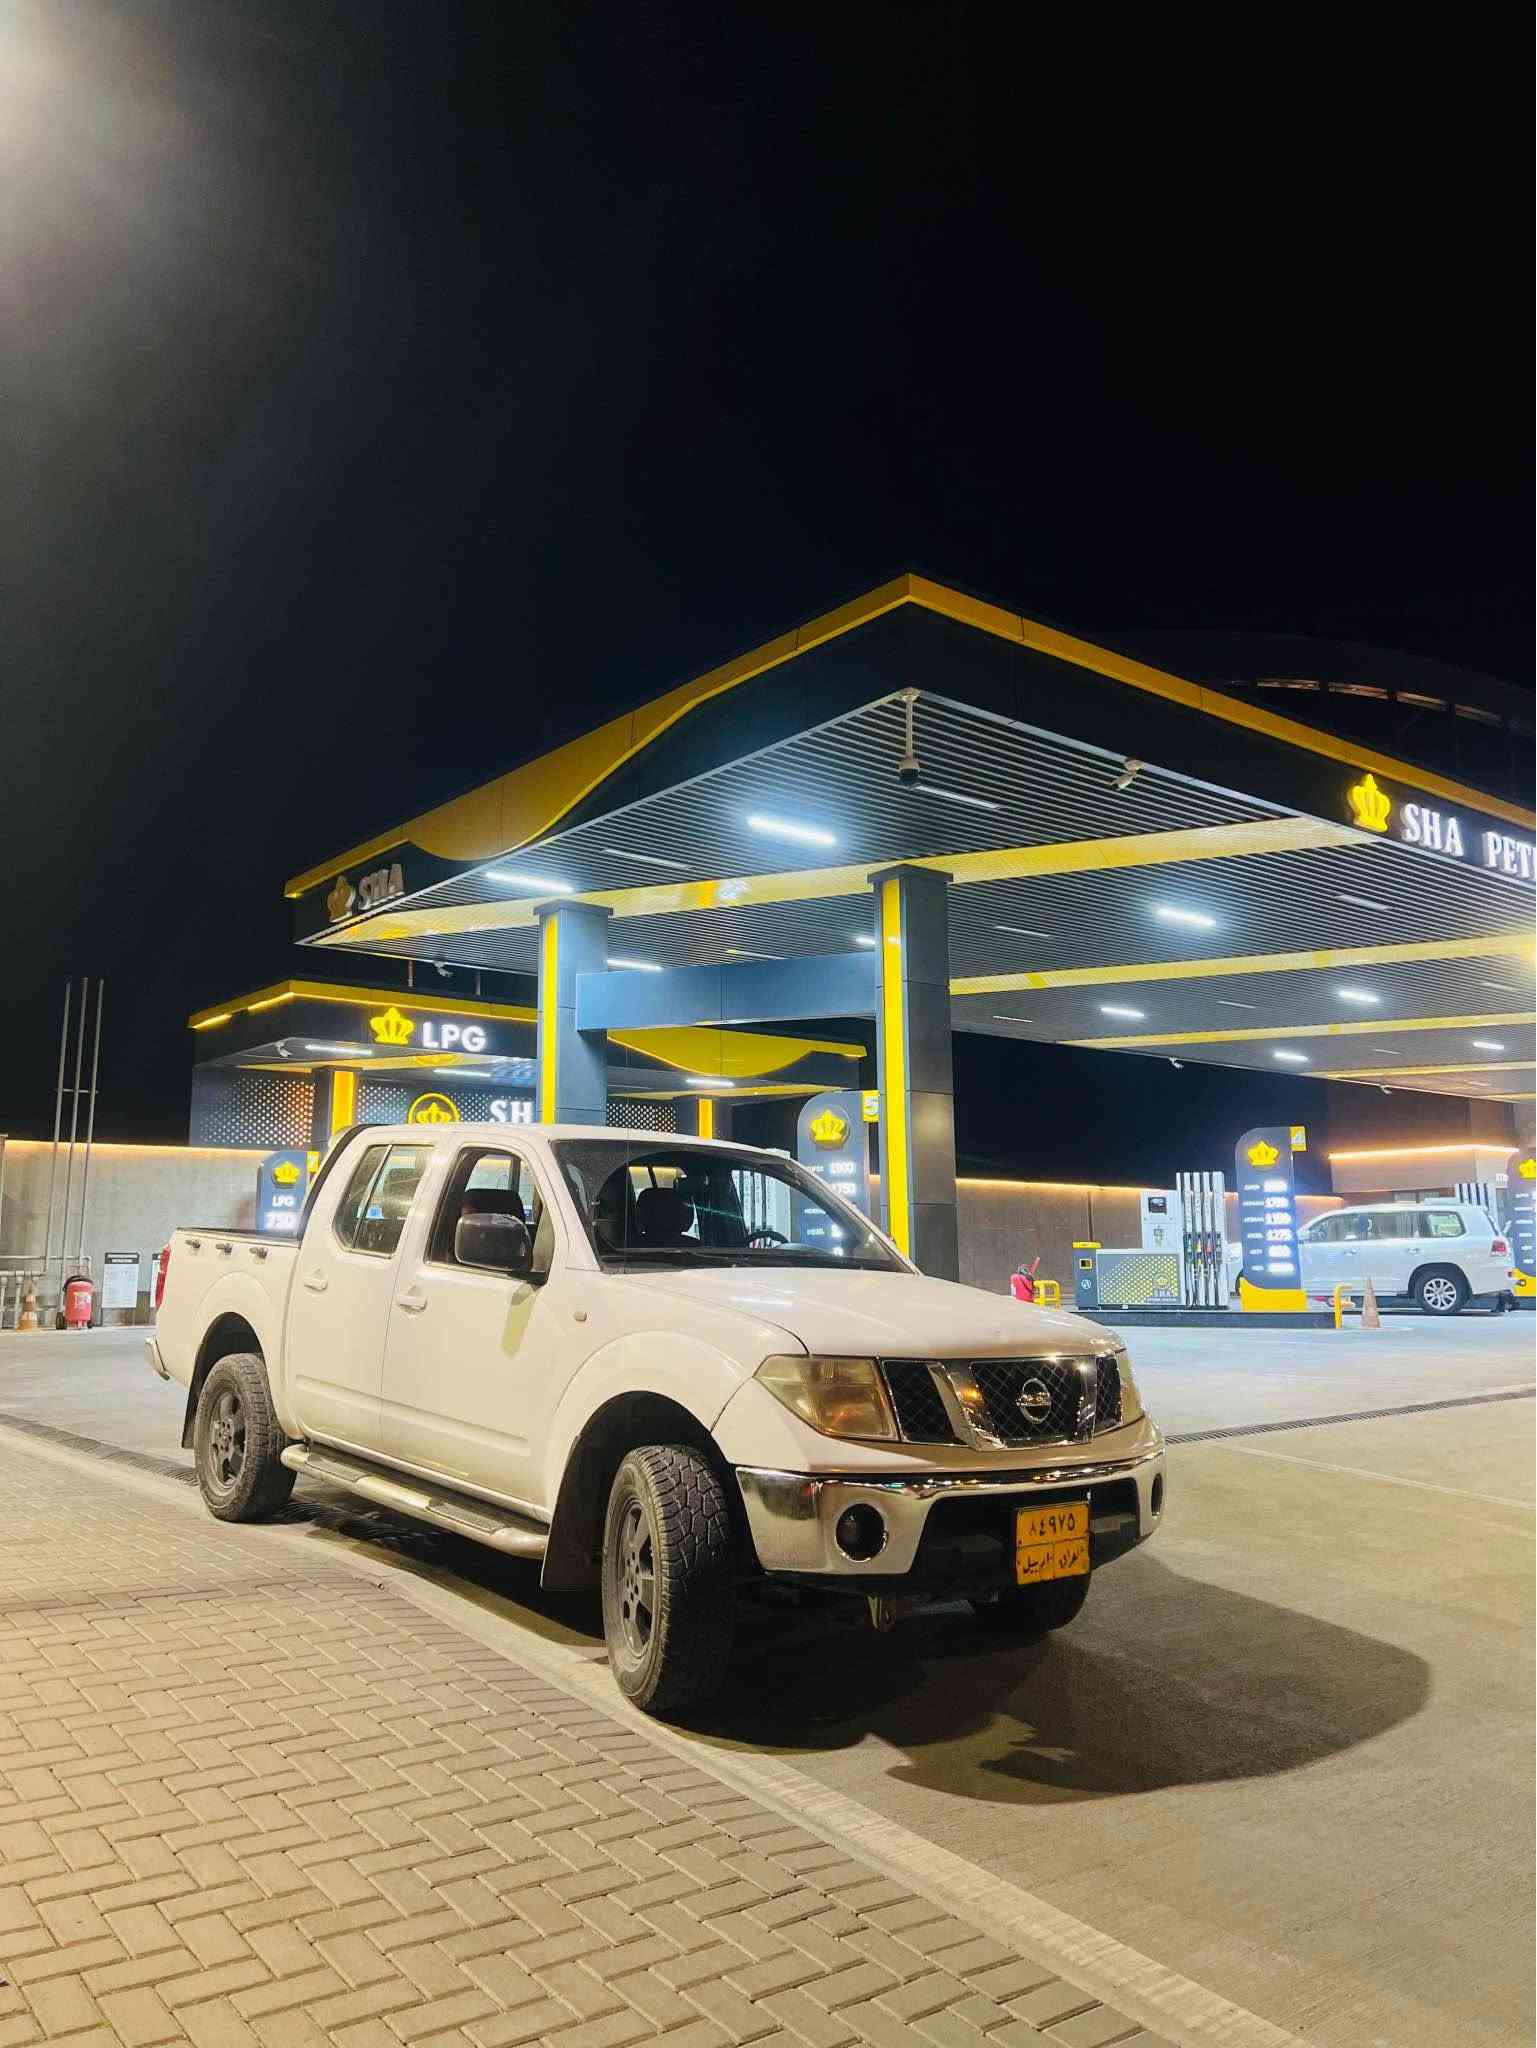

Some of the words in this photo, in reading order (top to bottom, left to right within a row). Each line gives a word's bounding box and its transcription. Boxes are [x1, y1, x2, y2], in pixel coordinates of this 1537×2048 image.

[1402, 804, 1464, 857] SHA
[422, 1021, 486, 1053] LPG
[272, 1195, 295, 1208] LPG
[1028, 1513, 1075, 1537] ٨٤٩٧٥
